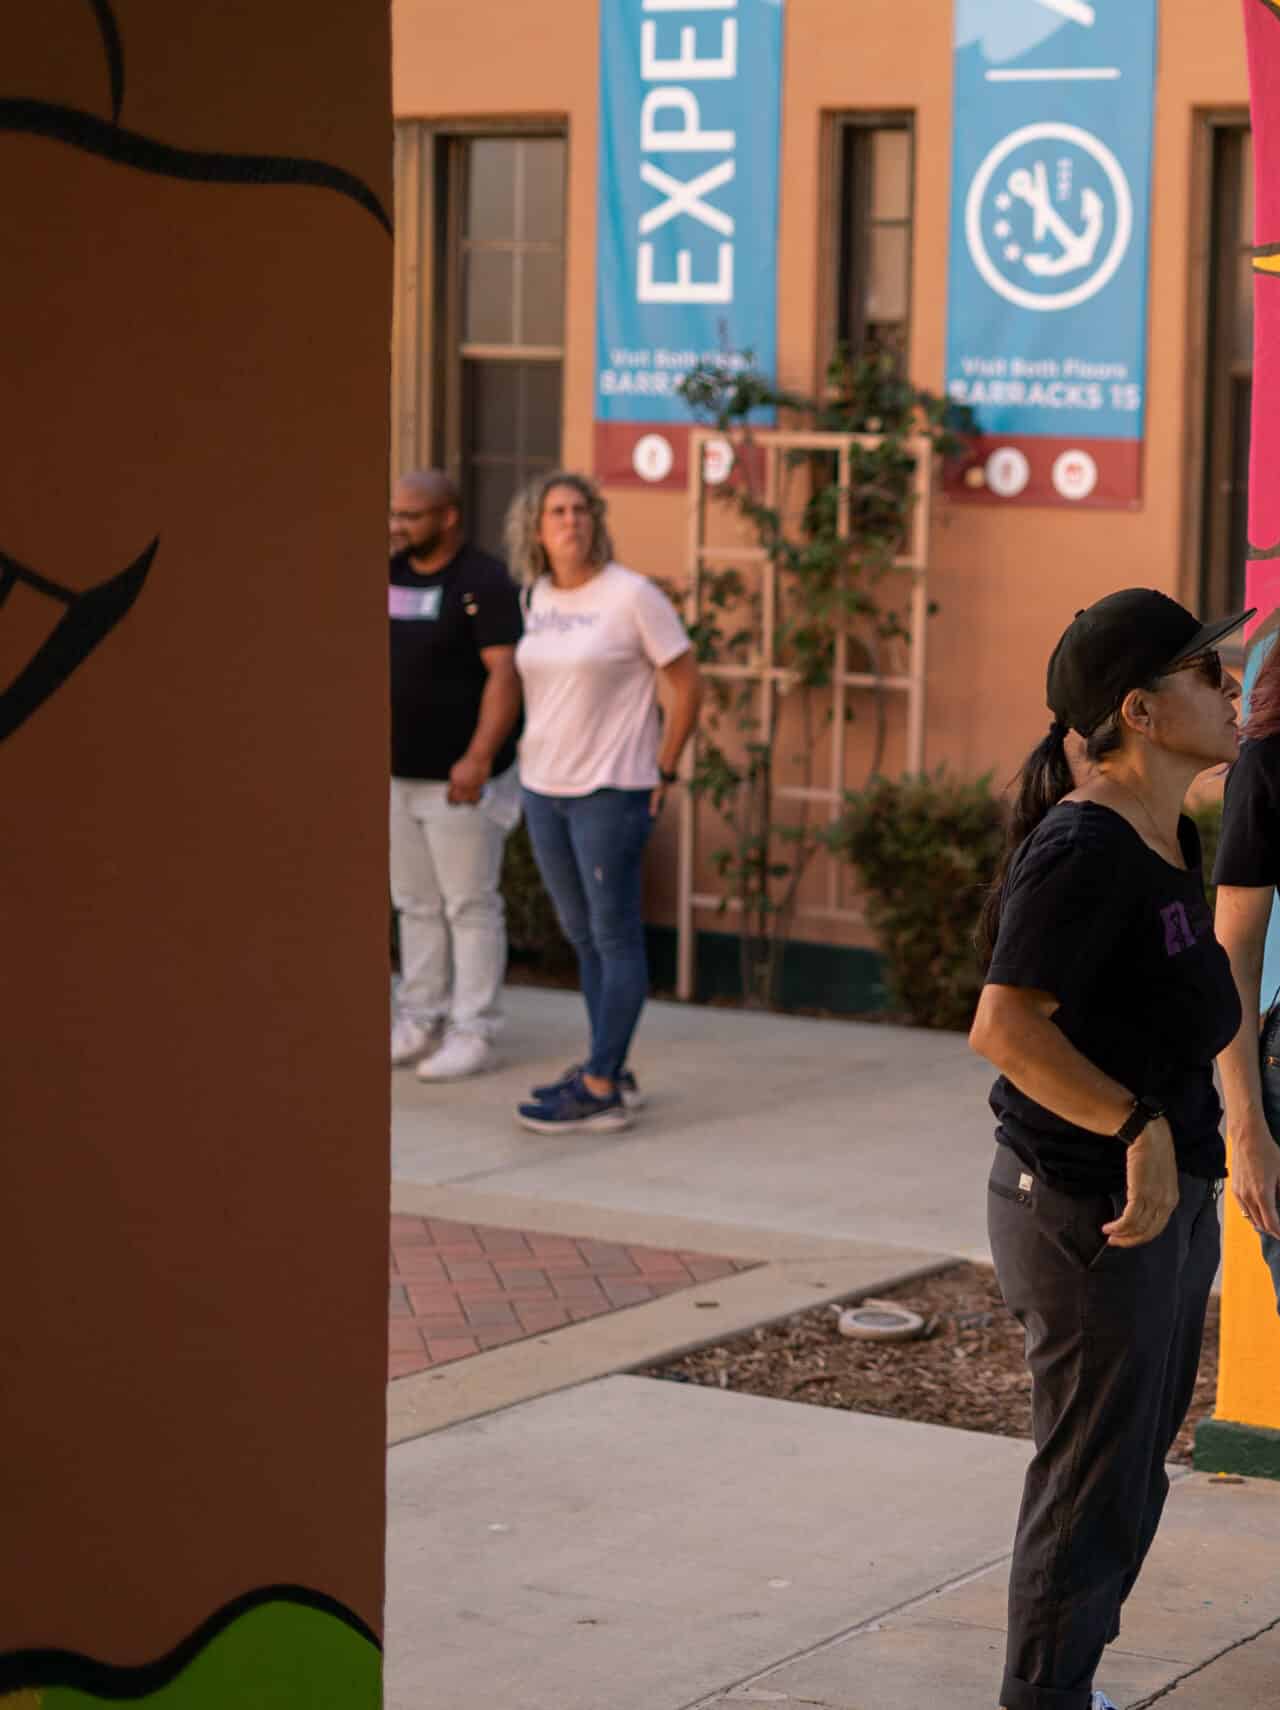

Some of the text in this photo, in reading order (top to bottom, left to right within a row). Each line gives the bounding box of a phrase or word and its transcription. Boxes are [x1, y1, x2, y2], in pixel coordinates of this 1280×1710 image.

[637, 0, 738, 304] EXPE
[960, 357, 1128, 379] Visit Both Floors
[949, 379, 1103, 409] BARRACKS
